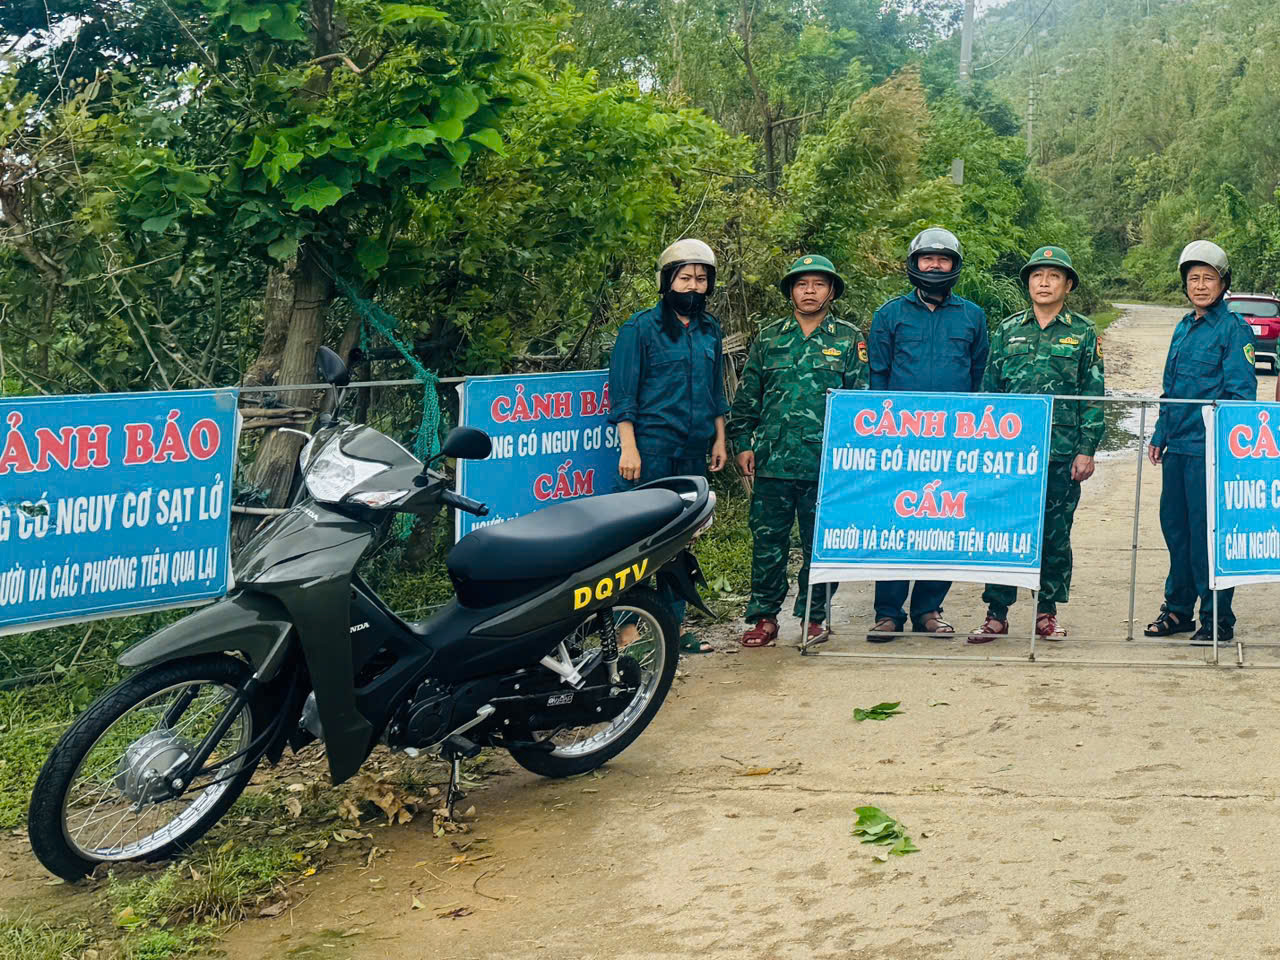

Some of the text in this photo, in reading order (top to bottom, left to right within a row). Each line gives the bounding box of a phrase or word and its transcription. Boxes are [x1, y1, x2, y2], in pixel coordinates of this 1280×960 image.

[491, 381, 611, 423] CẢNH BÁ
[854, 399, 1022, 439] CẢNH BÁO
[0, 408, 221, 474] ẢNH BÁO
[518, 428, 537, 456] CÓ
[541, 429, 579, 455] NGUY
[583, 425, 602, 451] CƠ
[533, 459, 594, 501] CẤM
[832, 443, 1039, 479] VÙNG CÓ NGUY CƠ SẠT LỞ
[55, 494, 118, 536] NGUY
[122, 488, 152, 528] CƠ
[156, 487, 194, 531] SẠT
[199, 473, 224, 521] LỞ
[894, 479, 968, 518] CẤM
[1224, 474, 1266, 510] VÙNG
[823, 523, 1032, 558] NGƯỜI VÀ CÁC PHƯƠNG TIỆN QUA LẠI
[1249, 525, 1280, 559] NGƯỜI
[0, 546, 217, 606] ƯỜI VÀ CÁC PHƯƠNG TIỆN QUA LẠI
[574, 558, 648, 610] DQTV
[350, 621, 370, 634] NDA
